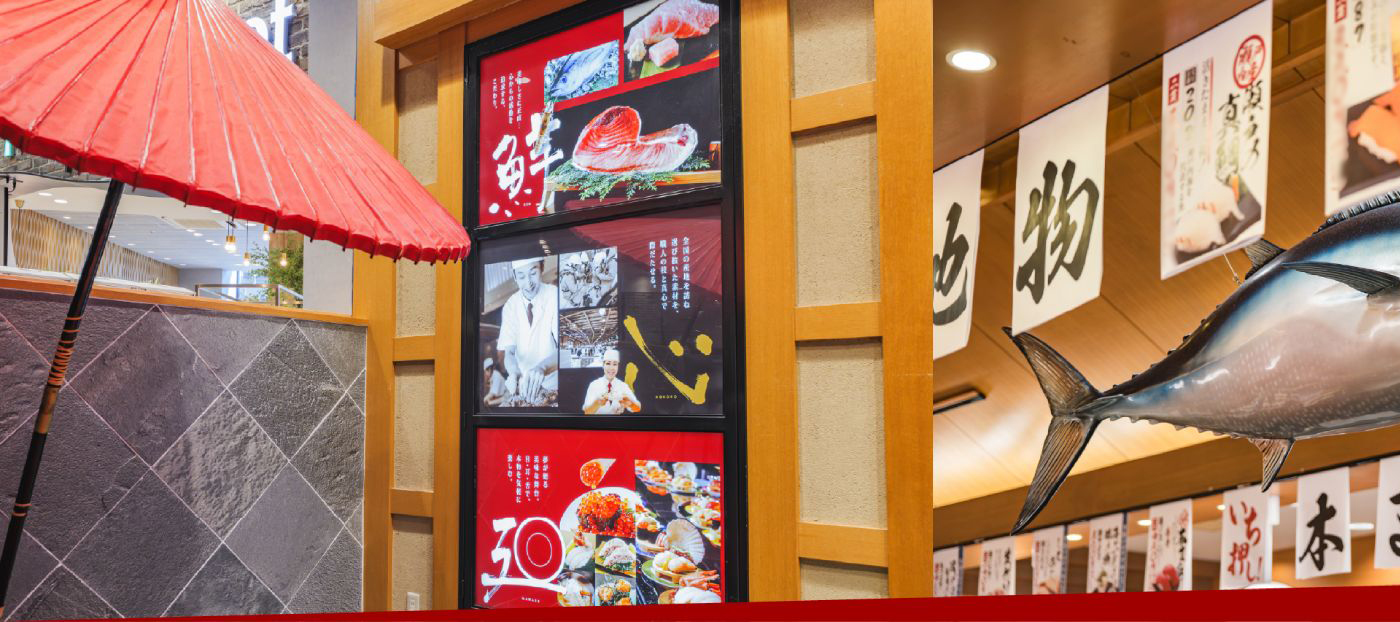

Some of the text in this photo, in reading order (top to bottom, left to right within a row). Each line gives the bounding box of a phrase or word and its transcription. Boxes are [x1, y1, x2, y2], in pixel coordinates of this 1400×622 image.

[659, 240, 668, 310] 職人の技と真心で
[682, 236, 690, 309] 全国の産地を訪ね
